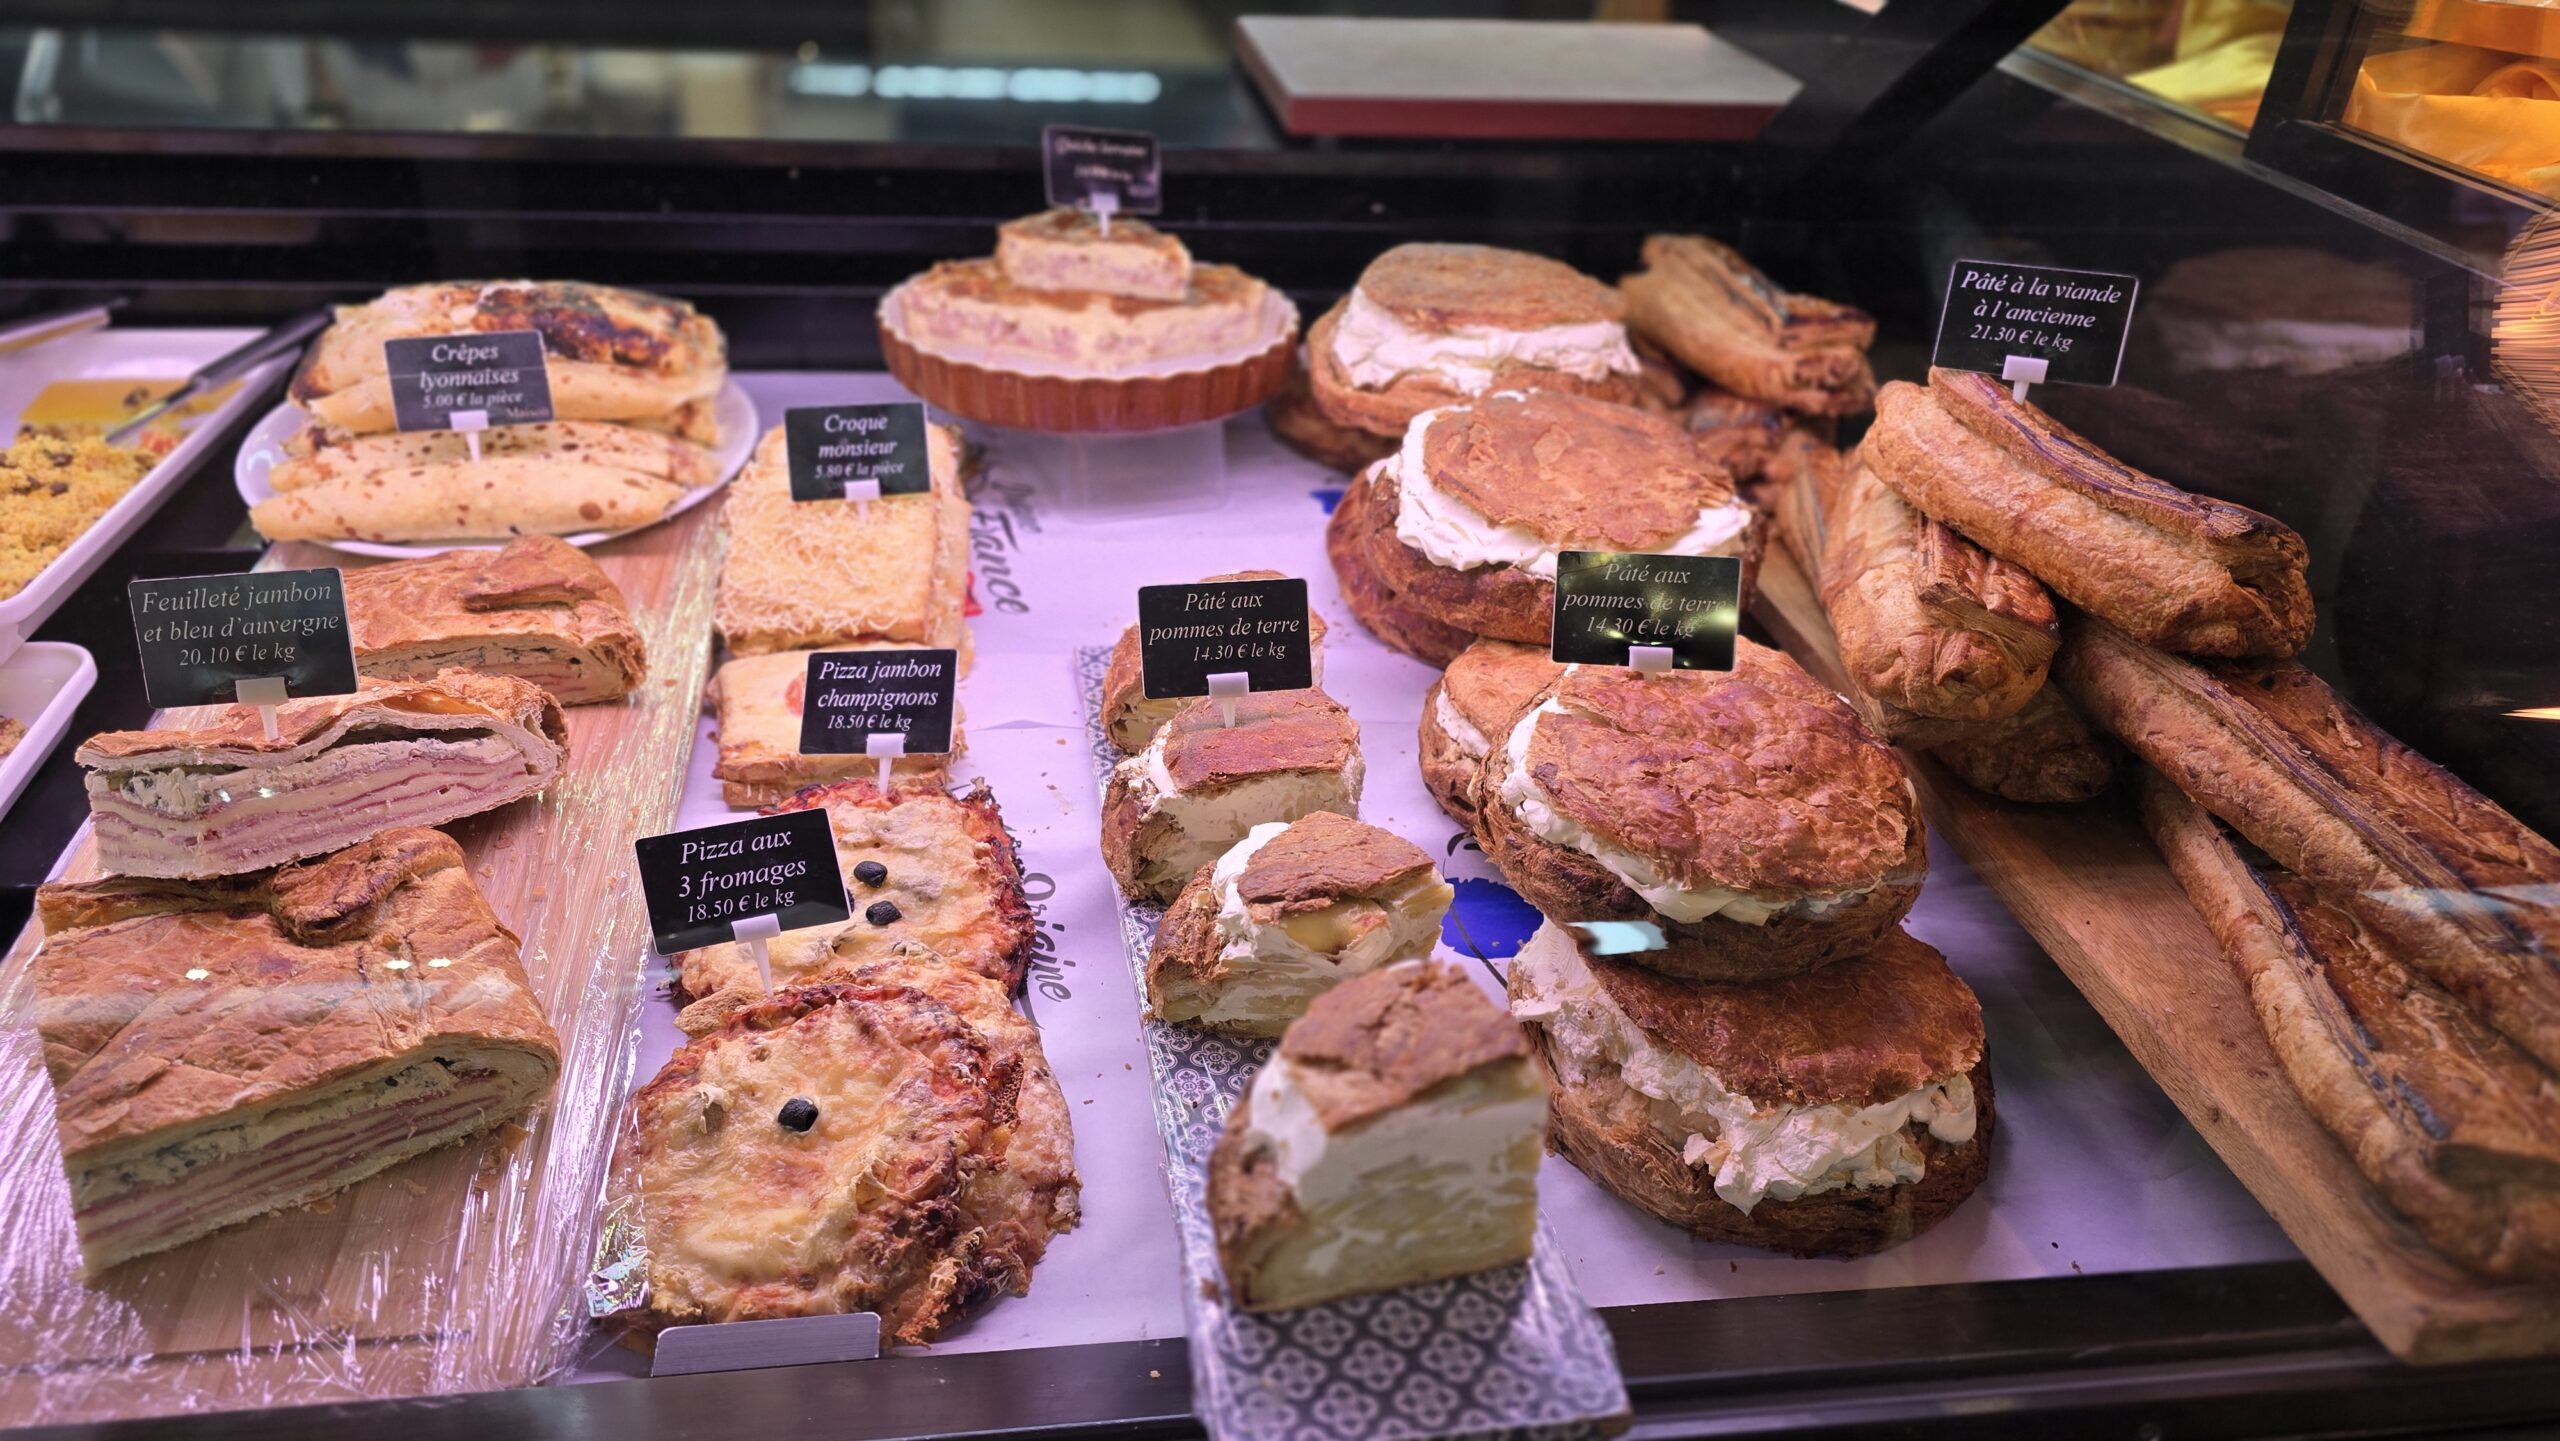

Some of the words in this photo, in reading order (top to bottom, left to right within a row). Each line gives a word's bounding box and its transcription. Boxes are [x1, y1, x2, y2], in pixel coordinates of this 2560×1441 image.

[1960, 270, 2008, 292] Pâté
[2010, 275, 2025, 294] à
[2028, 277, 2050, 297] la
[2055, 282, 2122, 304] viande
[1973, 299, 1988, 317] à
[1991, 300, 2096, 328] l’ancienne
[1970, 324, 2016, 342] 21.30
[2019, 330, 2033, 344] €
[2033, 330, 2048, 346] le
[2052, 333, 2073, 352] kg
[431, 343, 499, 365] Crêpes
[420, 368, 520, 393] lyonnaises
[470, 392, 484, 406] la
[486, 391, 523, 407] pièce
[824, 414, 888, 436] Croque
[818, 439, 898, 458] monsieur
[815, 463, 842, 479] 5.80
[845, 463, 855, 476] €
[856, 462, 869, 476] la
[871, 461, 904, 477] pièce
[1604, 563, 1650, 582] Pâté
[1654, 569, 1691, 584] aux
[142, 586, 240, 613] Feuilleté
[245, 582, 331, 611] jambon
[1184, 592, 1226, 612] Pâté
[1231, 594, 1264, 609] aux
[1562, 594, 1644, 611] pommes
[1650, 592, 1672, 610] de
[1679, 596, 1727, 612] terre
[144, 626, 162, 642] et
[170, 621, 213, 640] bleu
[220, 615, 339, 637] d’auvergne
[1148, 624, 1225, 645] pommes
[1230, 617, 1251, 636] de
[1257, 619, 1300, 634] terre
[1638, 619, 1651, 635] €
[1654, 621, 1668, 636] le
[1674, 620, 1696, 639] kg
[179, 647, 229, 666] 20.10
[235, 645, 247, 662] €
[253, 645, 266, 660] le
[274, 643, 295, 663] kg
[1193, 645, 1233, 661] 14.30
[1238, 643, 1248, 658] €
[1251, 643, 1264, 658] le
[1269, 642, 1286, 660] kg
[818, 661, 868, 680] Pizza
[868, 659, 942, 683] jambon
[817, 688, 938, 711] champignons
[827, 714, 864, 729] 18.50
[867, 714, 878, 729] €
[879, 714, 892, 728] le
[895, 714, 912, 732] kg
[680, 838, 744, 865] Pizza
[751, 831, 792, 851] aux
[679, 875, 691, 897] 3
[697, 860, 806, 900] fromages
[688, 898, 734, 923] 18.50
[739, 895, 750, 912] €
[755, 893, 769, 909] le
[775, 889, 795, 906] kg
